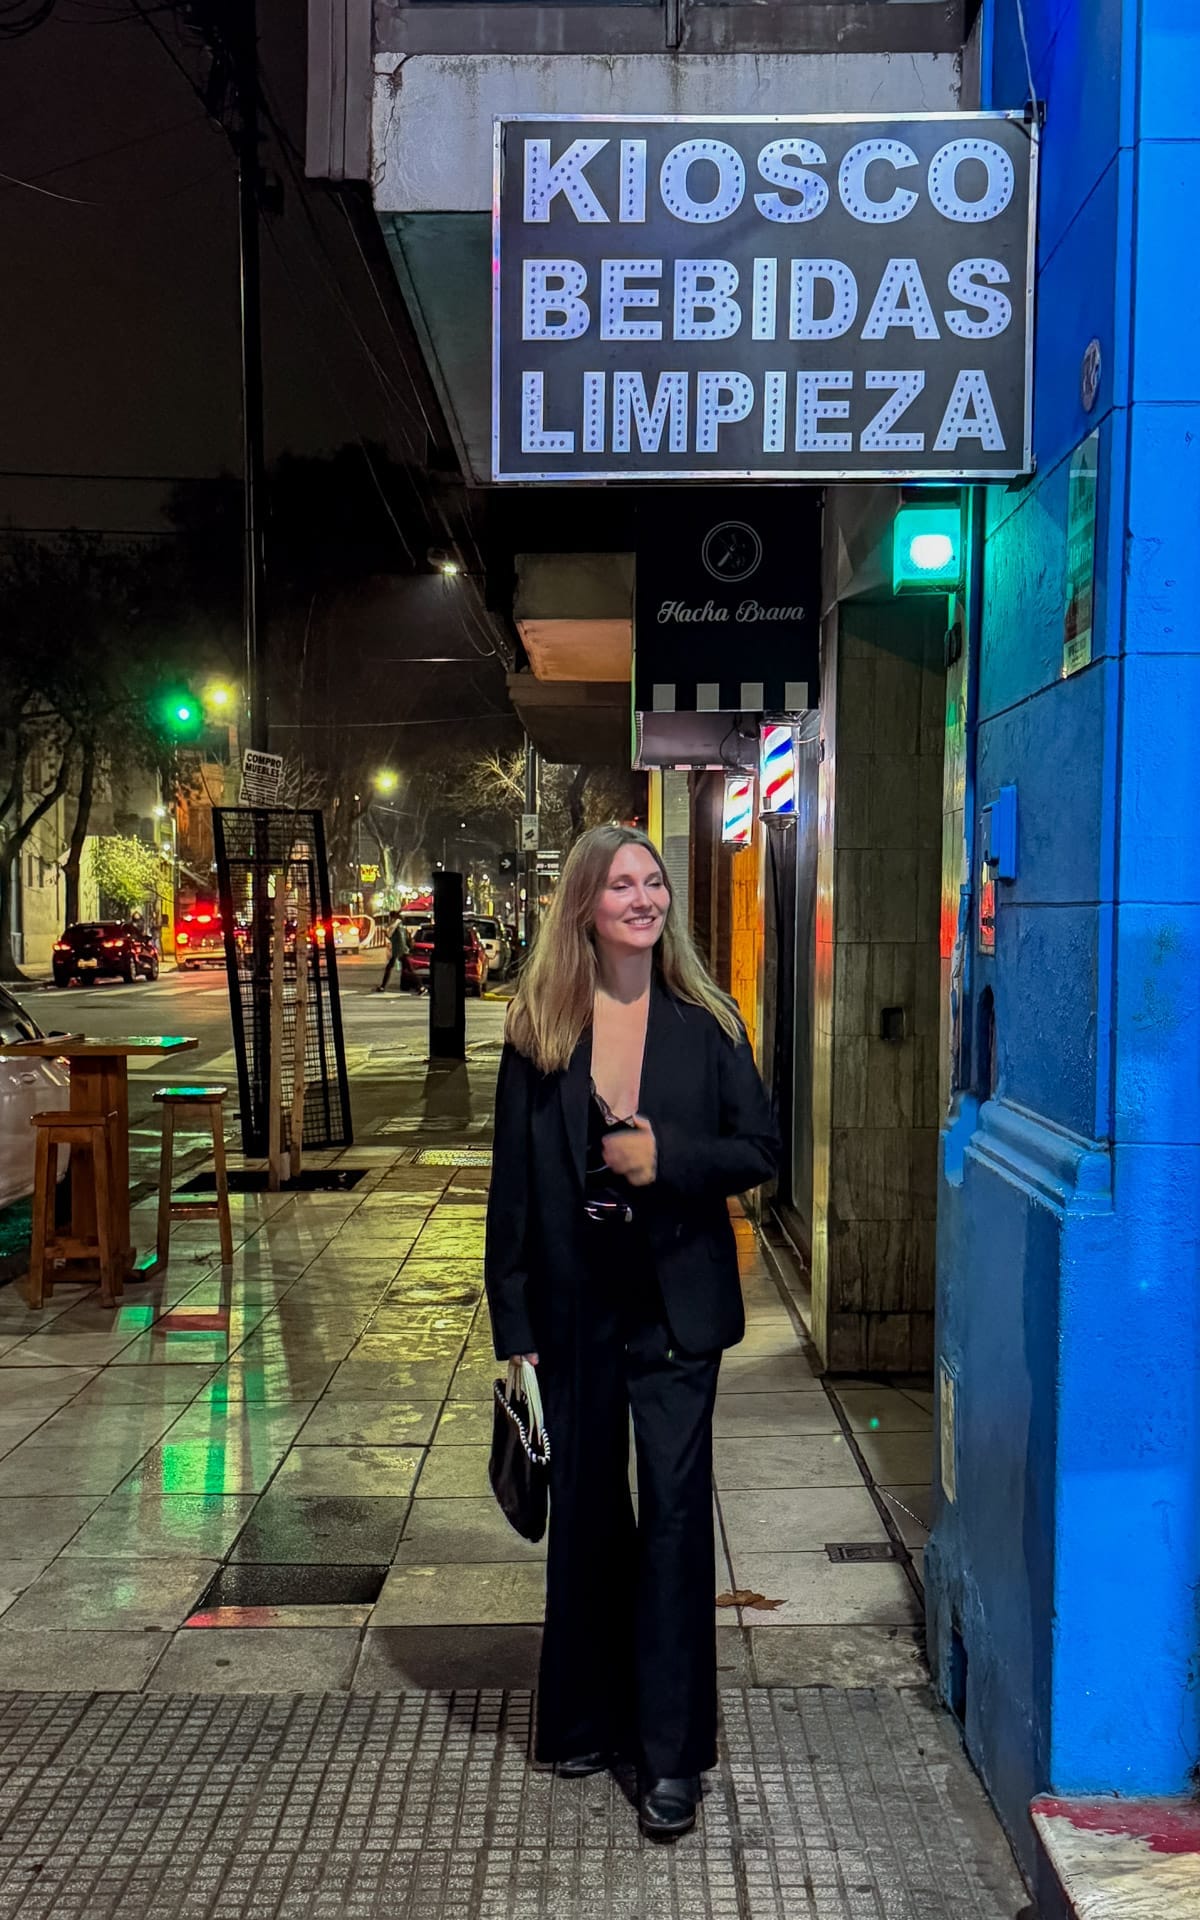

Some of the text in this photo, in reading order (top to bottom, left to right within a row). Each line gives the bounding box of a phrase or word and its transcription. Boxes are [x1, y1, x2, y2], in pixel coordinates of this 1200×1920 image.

[523, 138, 1014, 224] KIOSCO
[521, 257, 1012, 341] BEBIDAS
[521, 369, 1007, 454] LIMPIEZA
[657, 599, 806, 624] Hacha Brava
[245, 763, 280, 777] MUEBLES
[246, 753, 282, 768] COMPRO
